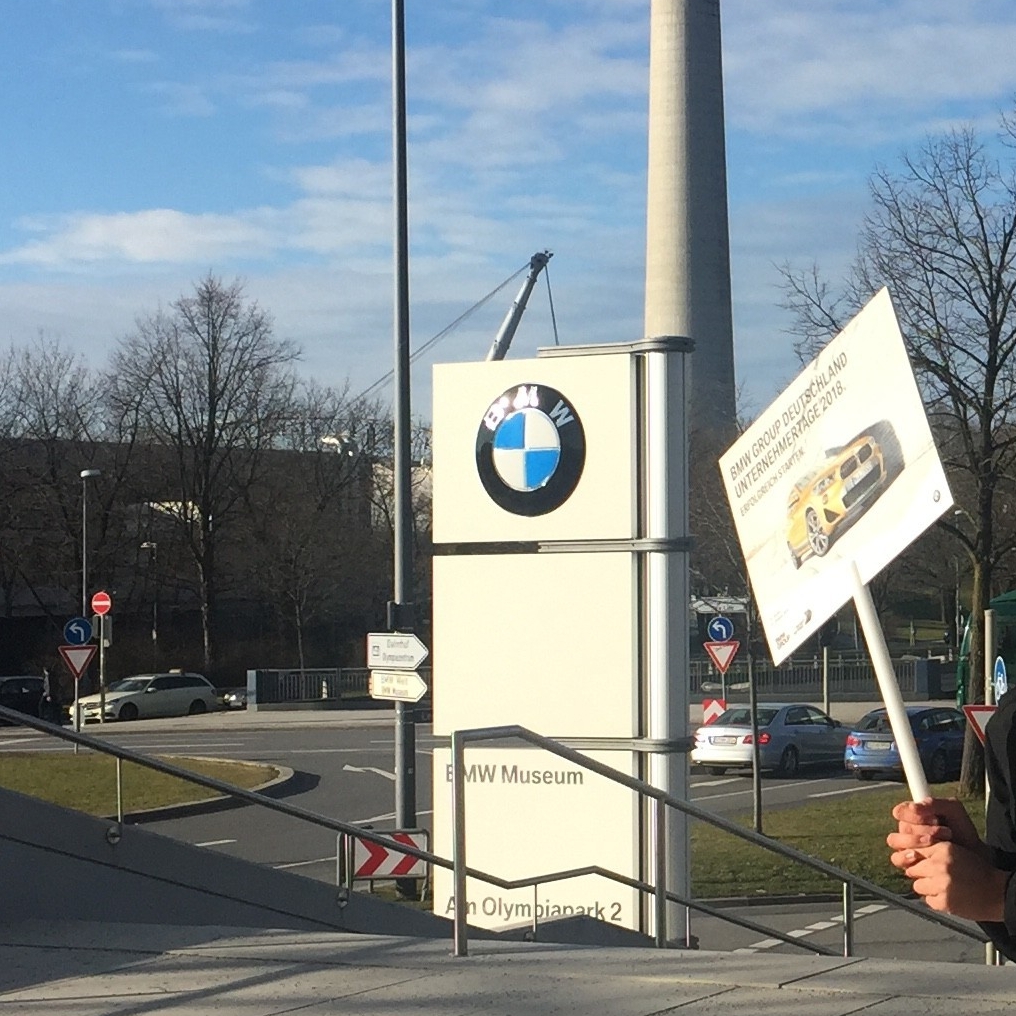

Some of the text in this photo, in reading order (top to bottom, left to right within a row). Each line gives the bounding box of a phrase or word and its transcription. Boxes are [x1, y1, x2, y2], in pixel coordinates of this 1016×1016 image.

[484, 386, 574, 431] BMW
[730, 351, 848, 481] BMW GROUP DEUTSCHLAND
[734, 380, 847, 499] UNTERNEHMERTAGE 2018.
[501, 765, 584, 785] Museum
[611, 902, 622, 921] 2
